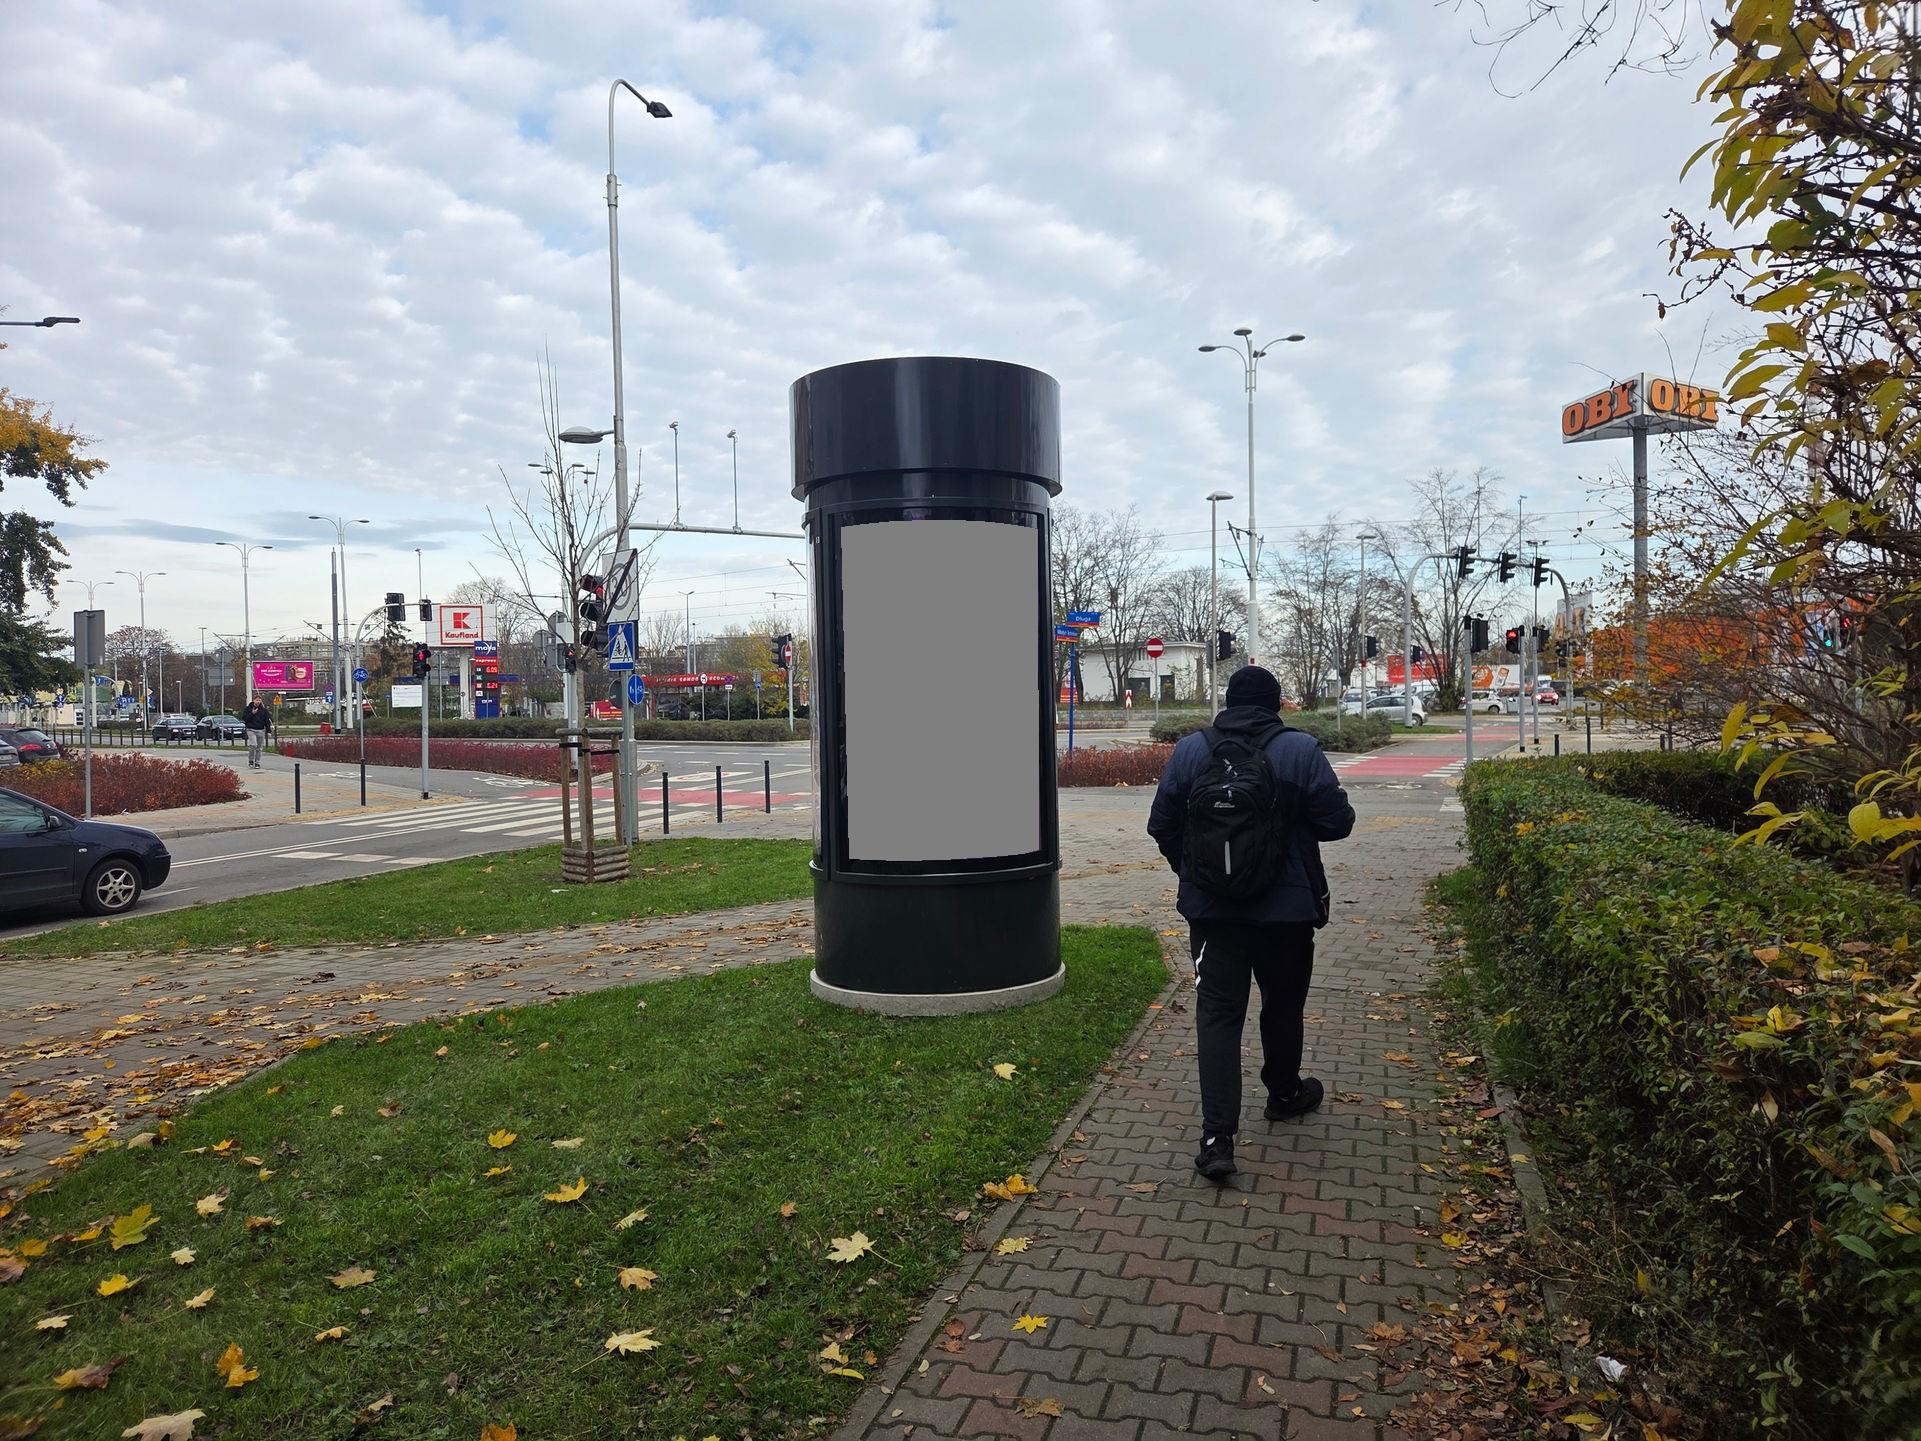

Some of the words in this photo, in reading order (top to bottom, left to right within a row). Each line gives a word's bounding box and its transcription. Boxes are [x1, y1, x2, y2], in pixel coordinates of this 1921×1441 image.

[1562, 380, 1635, 436] OBI
[1650, 379, 1719, 422] OBI
[445, 631, 479, 639] Kaufland
[475, 642, 496, 655] moya
